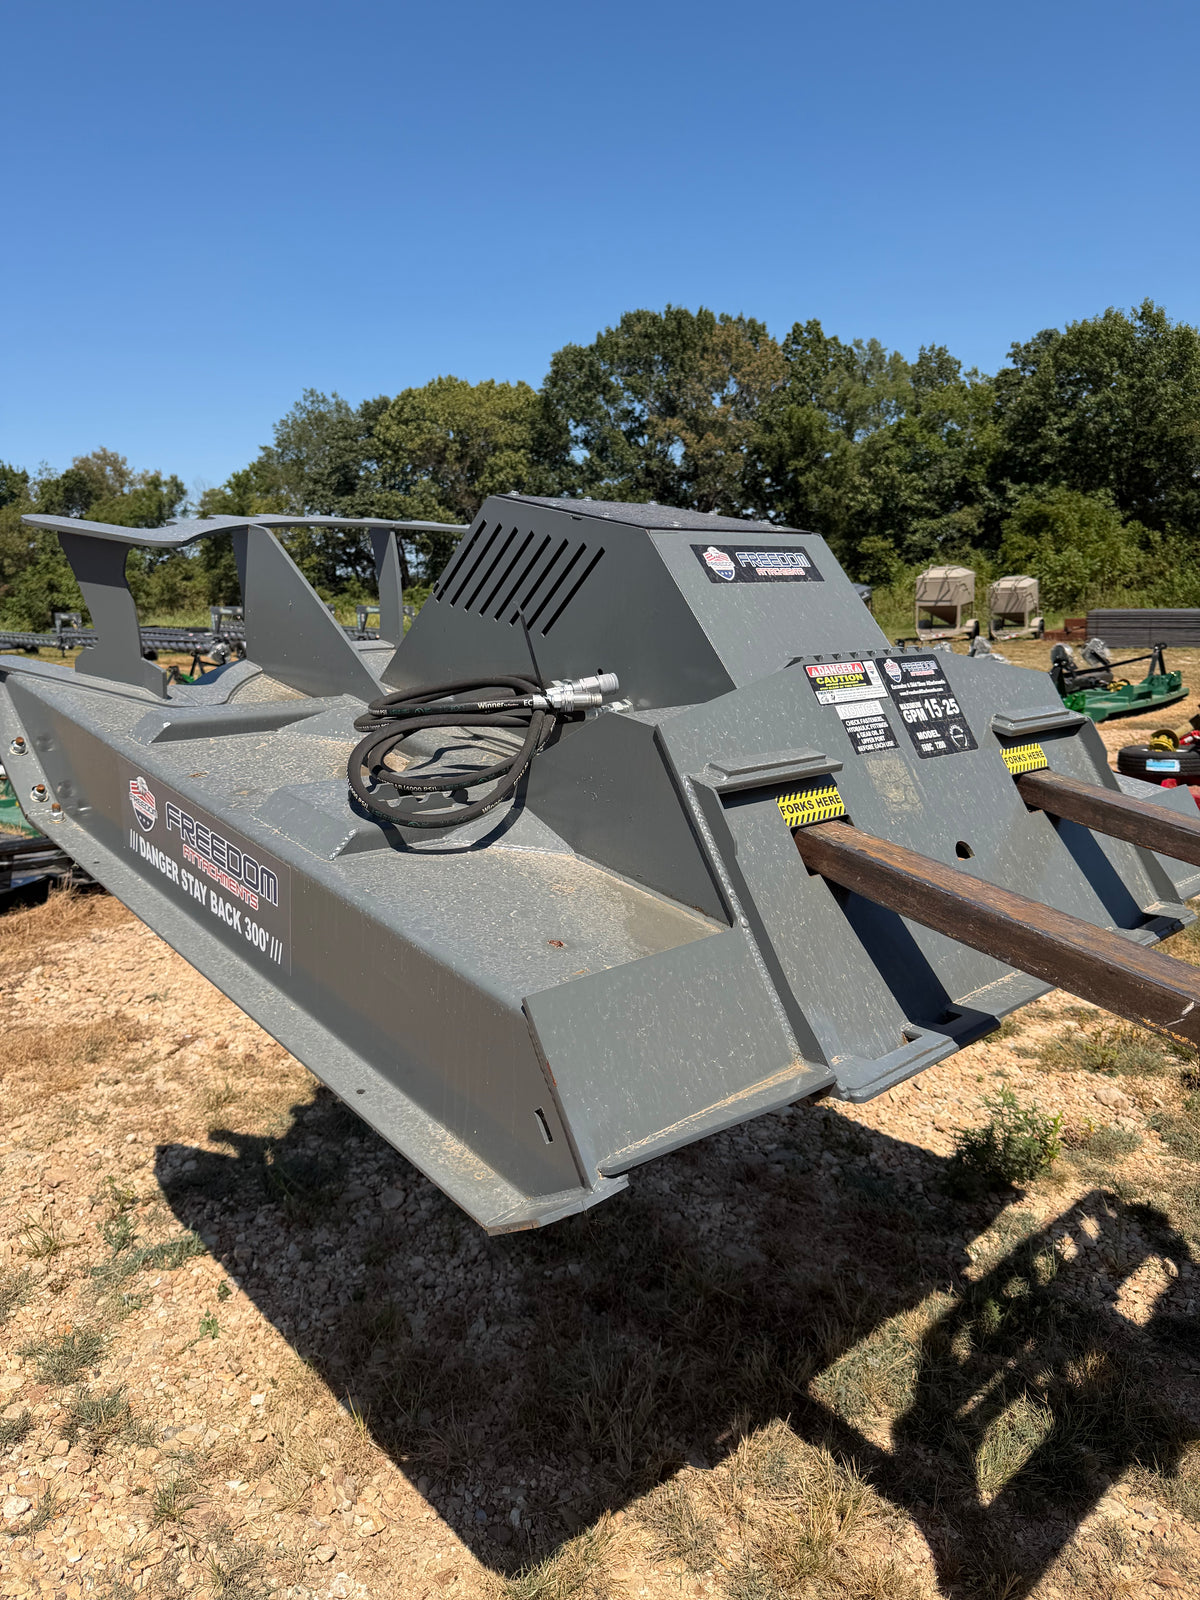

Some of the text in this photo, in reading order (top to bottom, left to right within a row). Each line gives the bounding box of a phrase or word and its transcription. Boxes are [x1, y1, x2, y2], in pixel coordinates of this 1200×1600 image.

[736, 552, 811, 568] FREEDOM
[818, 664, 853, 675] DANGER
[816, 674, 864, 684] CAUTION
[841, 702, 880, 718] NOTICE
[903, 698, 960, 723] GPM 15-25
[916, 730, 941, 740] MODEL
[1004, 750, 1044, 765] FORKS HERE
[780, 794, 842, 815] FORKS HERE
[165, 801, 278, 907] FREEDOM
[140, 836, 179, 885] DANGER
[181, 869, 207, 905] STAY
[210, 890, 242, 934] BACK
[183, 844, 258, 910] ATTACHMENTS
